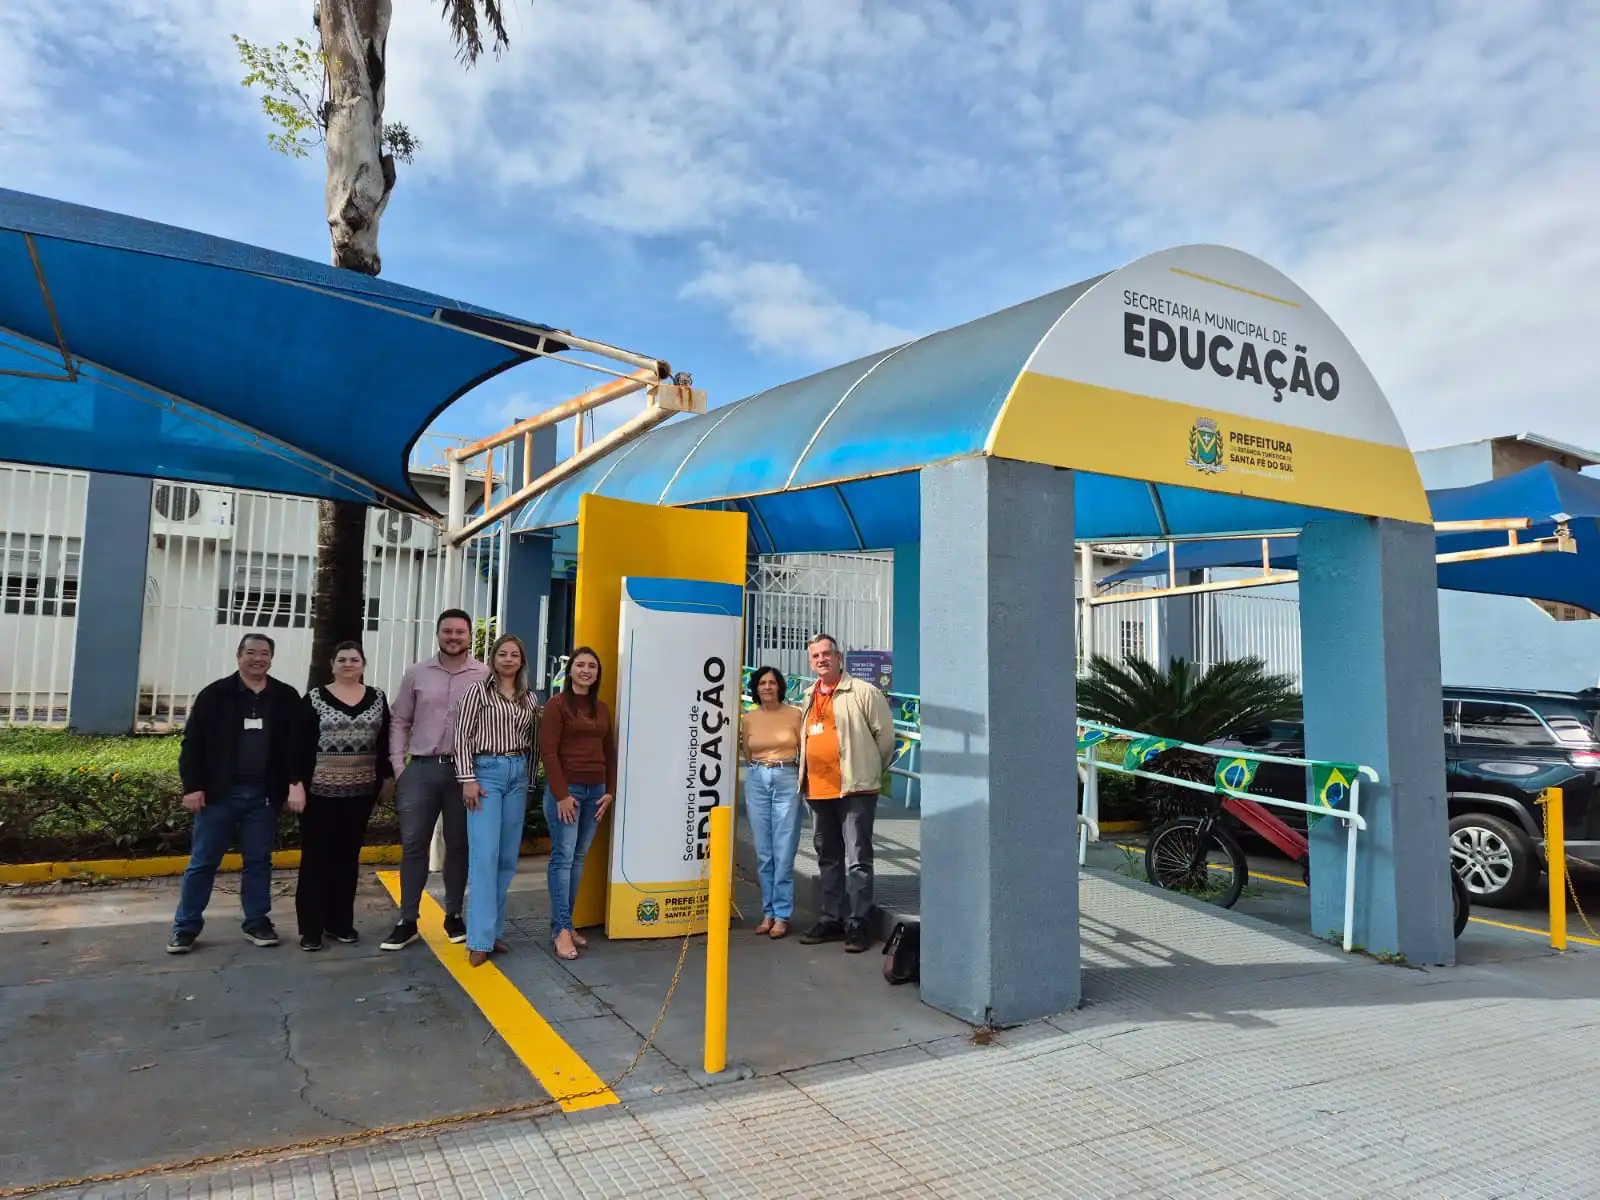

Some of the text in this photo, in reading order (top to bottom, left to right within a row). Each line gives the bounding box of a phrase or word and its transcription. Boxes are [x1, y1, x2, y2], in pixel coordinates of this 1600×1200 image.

[1123, 290, 1288, 346] SECRETARIA MUNICIPAL DE
[1123, 311, 1340, 403] EDUCAÇÃO
[1230, 432, 1292, 453] PREFEITURA
[1230, 454, 1255, 465] SANTA
[1267, 460, 1278, 469] DO
[1279, 462, 1294, 472] SUL
[682, 705, 699, 861] Secretaria Municipal de
